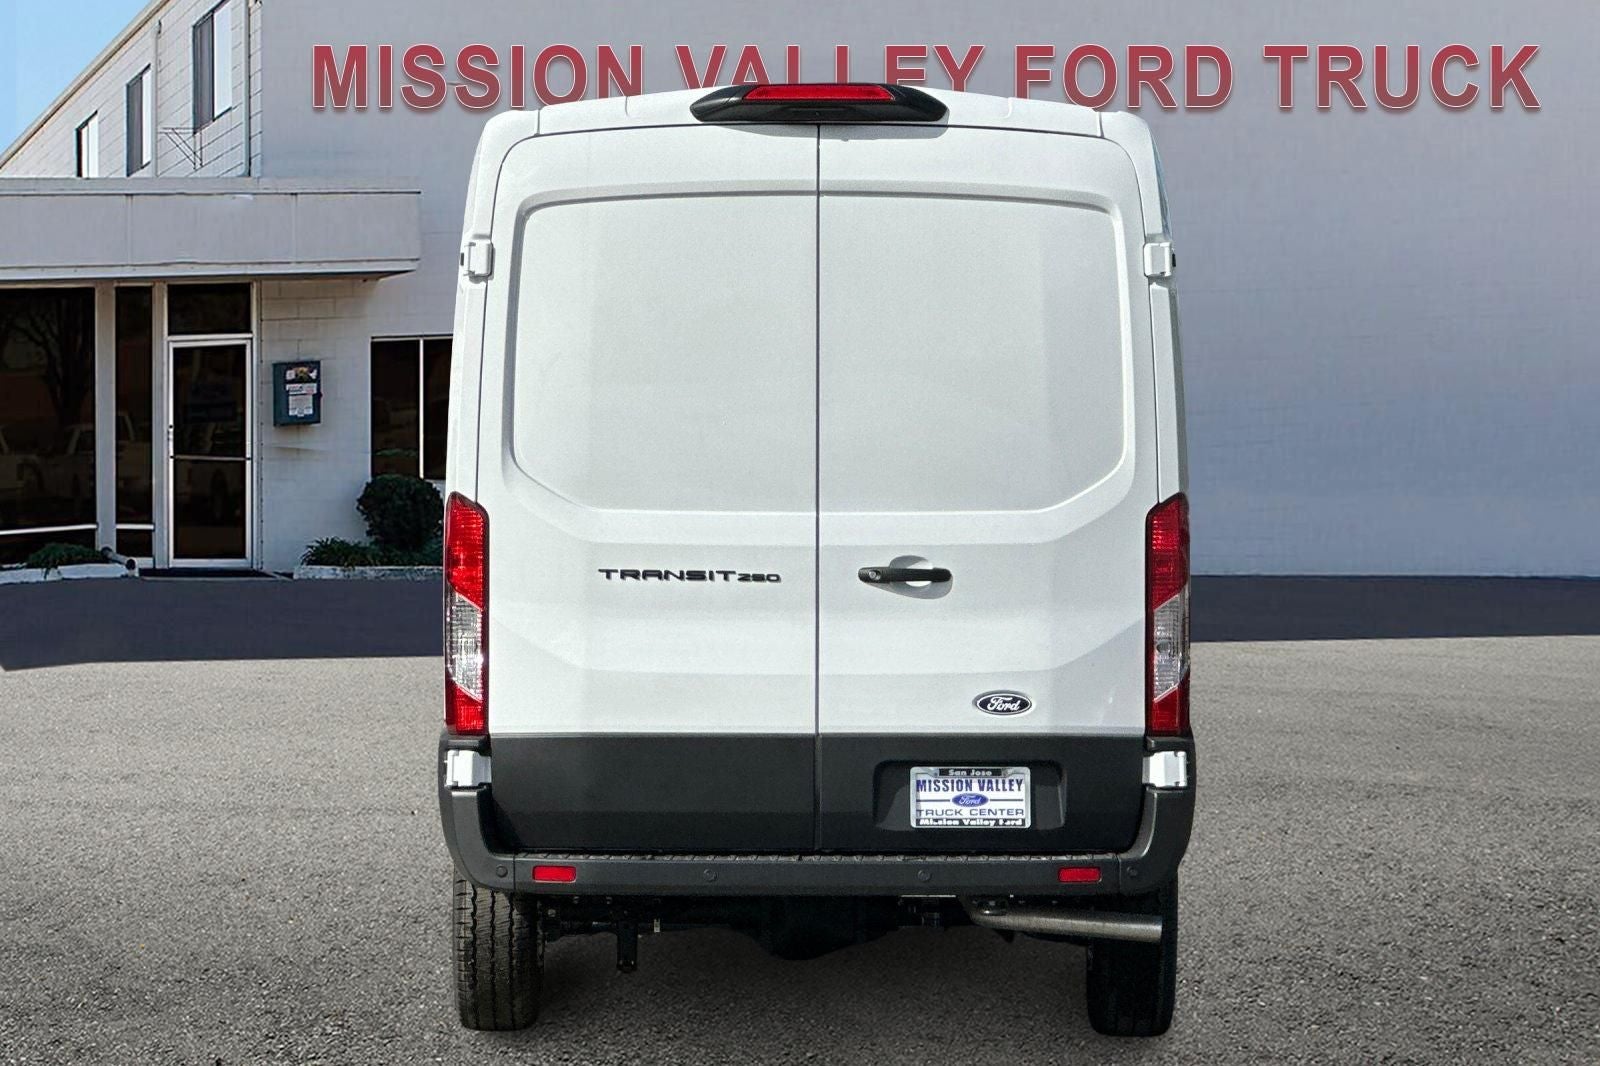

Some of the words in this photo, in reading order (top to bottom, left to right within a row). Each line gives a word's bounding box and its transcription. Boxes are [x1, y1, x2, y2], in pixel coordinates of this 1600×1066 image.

[312, 44, 643, 110] MISSION
[1015, 43, 1233, 109] FORD
[1264, 43, 1541, 110] TRUCK
[598, 569, 736, 582] TRANSIT
[987, 696, 1021, 711] Ford
[916, 779, 972, 792] MISSION
[978, 779, 1023, 792] VALLEY
[958, 795, 982, 805] Ford
